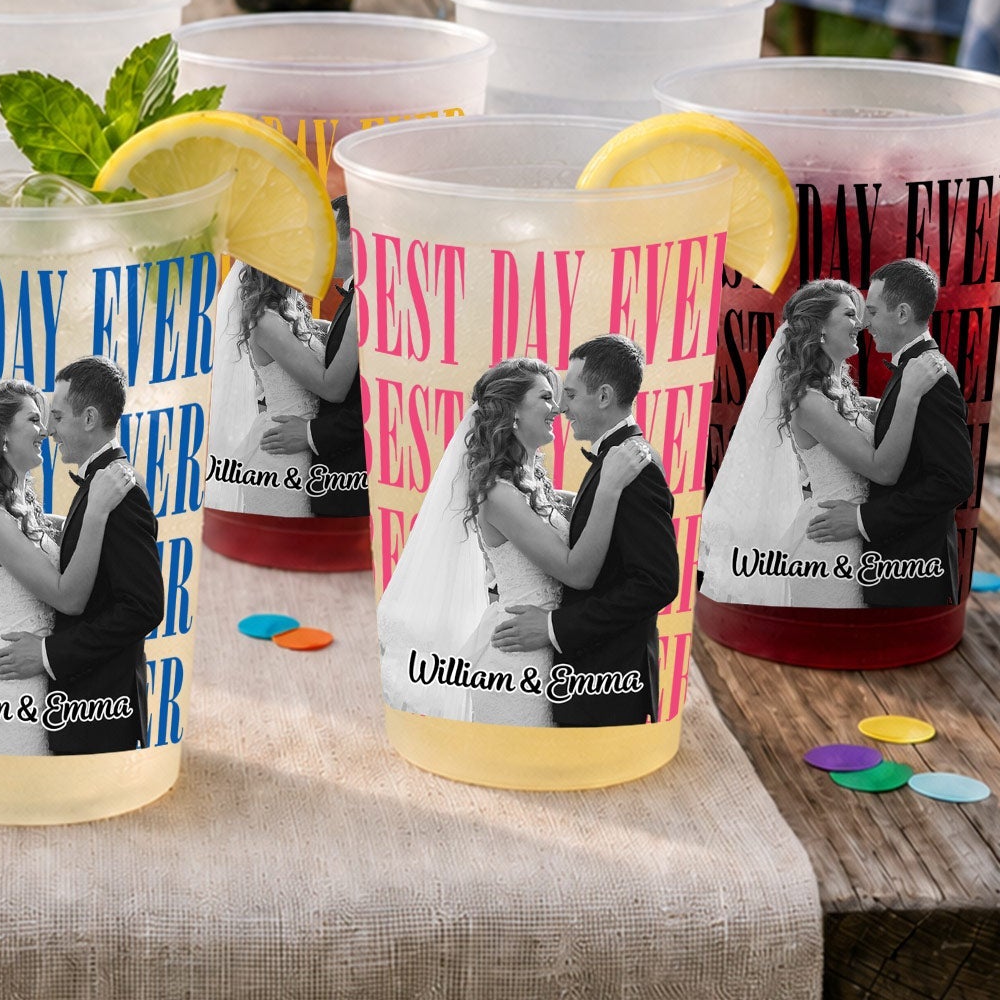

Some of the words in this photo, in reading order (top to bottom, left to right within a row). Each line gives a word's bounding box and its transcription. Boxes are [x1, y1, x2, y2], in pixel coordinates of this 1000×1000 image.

[796, 183, 883, 290] DAY
[905, 175, 1000, 290] EVE
[93, 251, 217, 386] EVER
[491, 249, 585, 371] DAY
[284, 467, 302, 490] &
[305, 463, 368, 497] Emm
[732, 547, 829, 578] William
[832, 555, 854, 579] &
[856, 551, 944, 587] Emma
[408, 649, 516, 692] William
[520, 667, 542, 694] &
[545, 663, 644, 704] Emma
[17, 694, 38, 722] &
[41, 690, 133, 731] Emma
